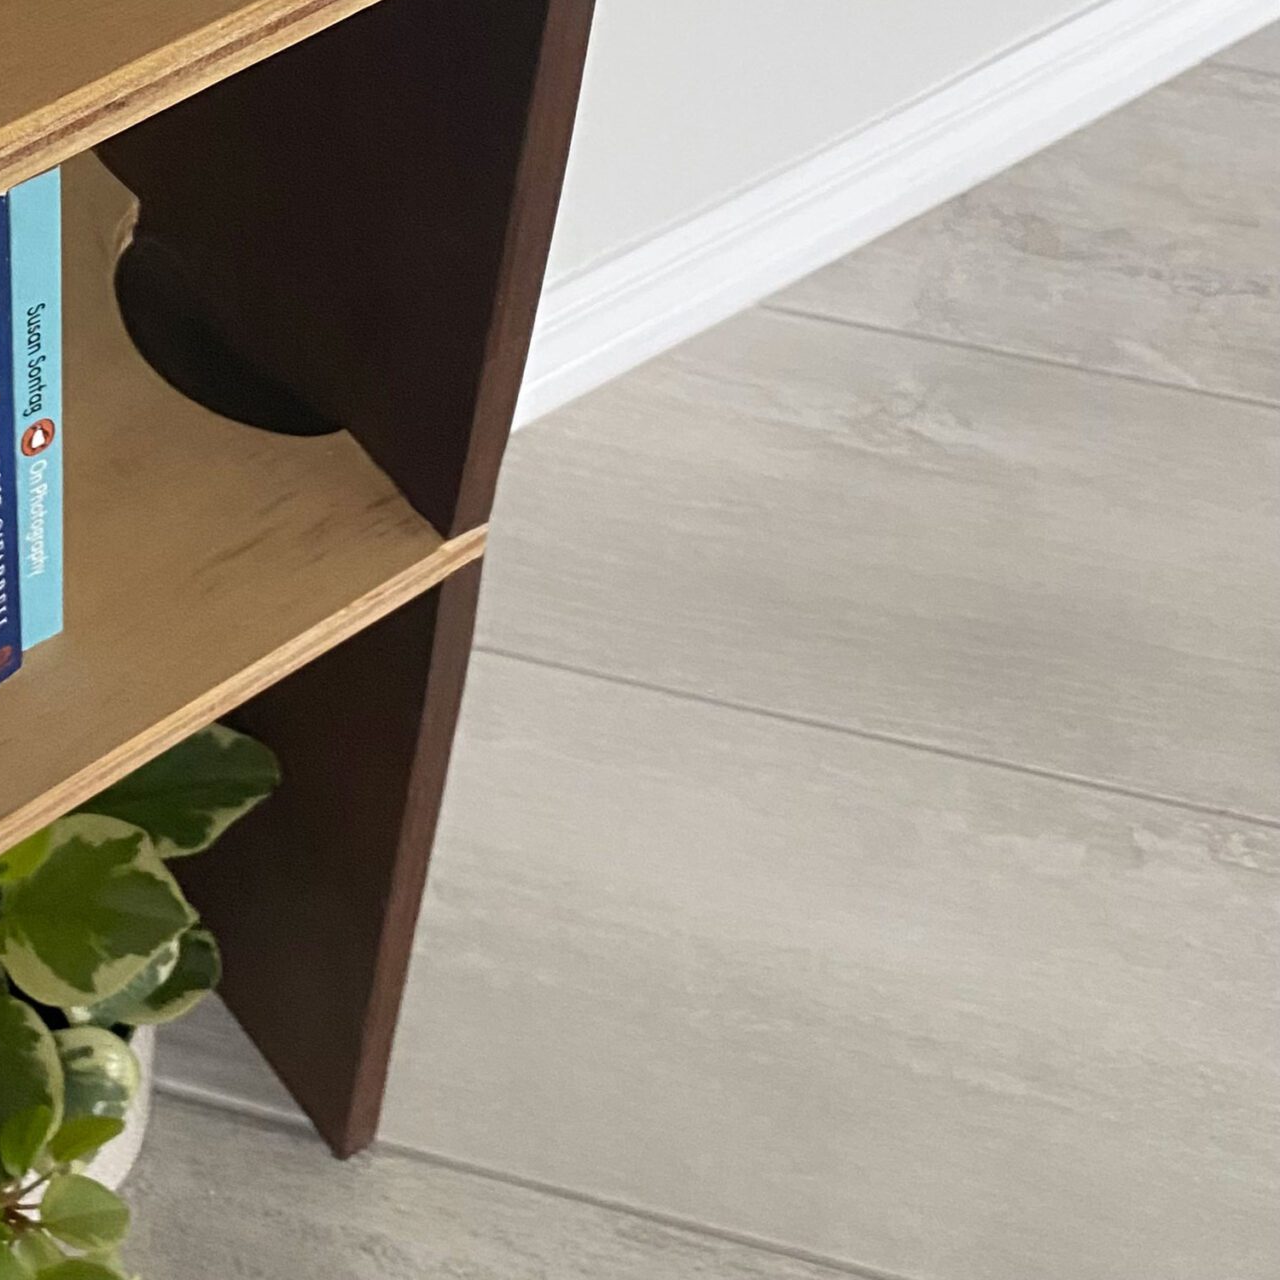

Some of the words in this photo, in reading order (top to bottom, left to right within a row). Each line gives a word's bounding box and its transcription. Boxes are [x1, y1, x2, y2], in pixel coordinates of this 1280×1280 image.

[26, 302, 46, 357] Susan
[23, 355, 47, 418] Sontag
[29, 458, 49, 486] On
